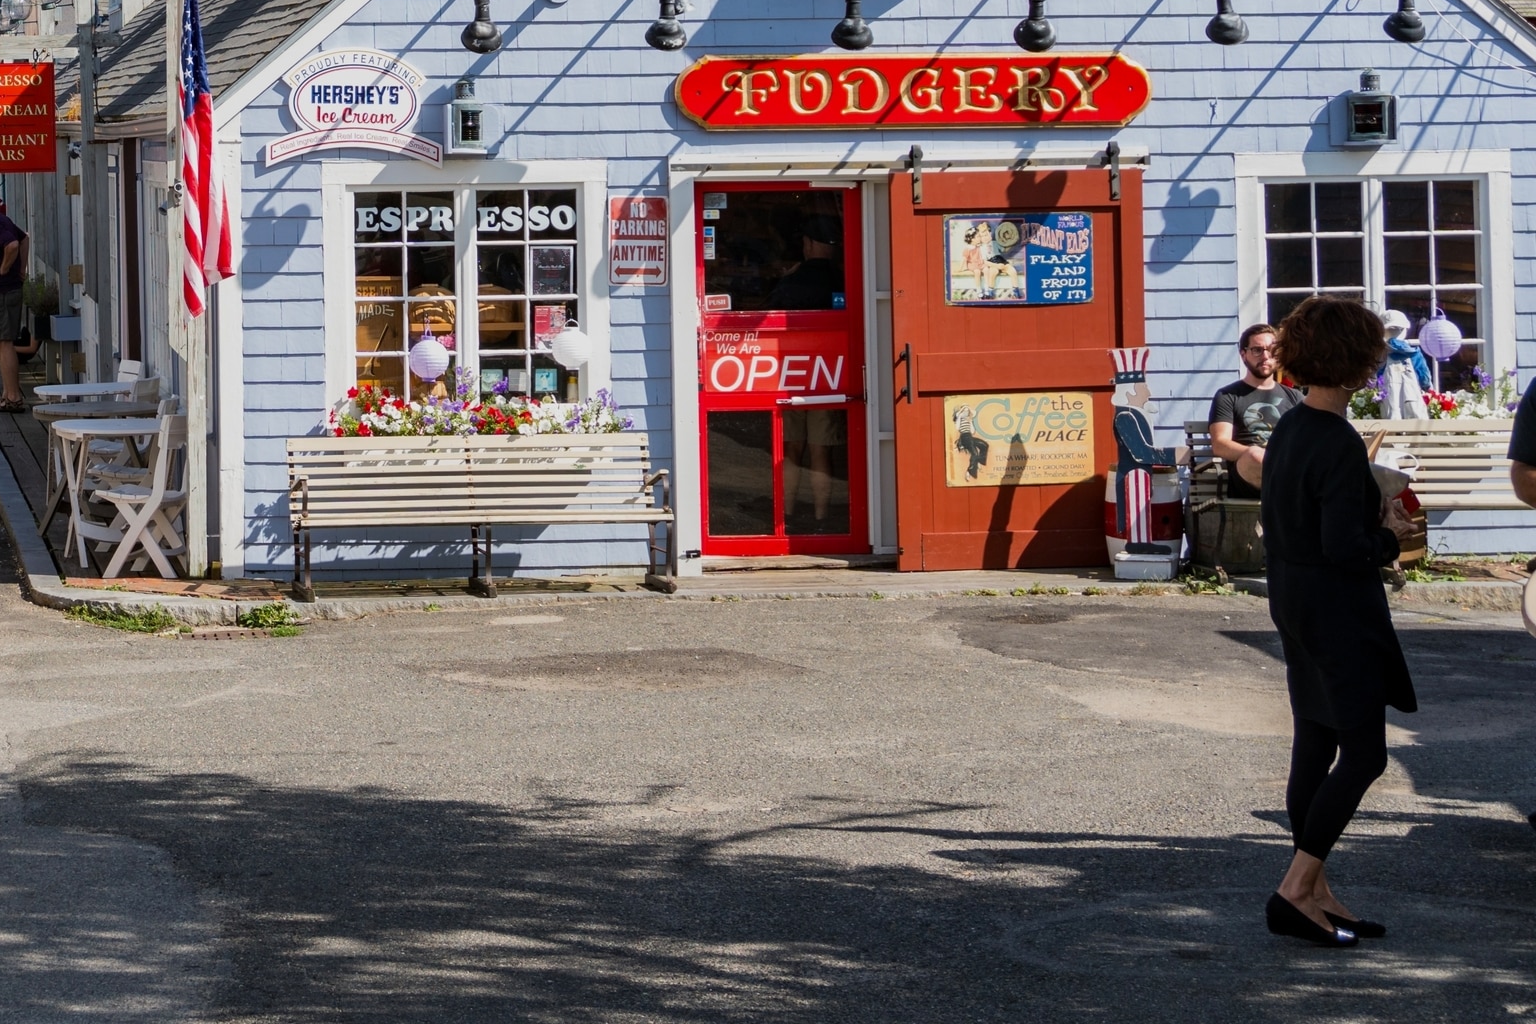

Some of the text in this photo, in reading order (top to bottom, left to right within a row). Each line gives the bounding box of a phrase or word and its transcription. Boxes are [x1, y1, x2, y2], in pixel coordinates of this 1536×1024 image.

[294, 53, 418, 85] PROUDLY FEATURING
[311, 85, 401, 105] HERSHEY'S
[722, 65, 1110, 115] FUDGERY
[316, 105, 396, 124] Ice Cream
[279, 141, 295, 152] Real
[336, 132, 352, 141] Real
[354, 132, 364, 141] Ice
[392, 136, 409, 146] Real
[630, 202, 647, 218] NO
[611, 219, 666, 237] PARKING
[1020, 222, 1090, 254] ELEPHANT EARS
[613, 244, 665, 262] ANYTIME
[1030, 254, 1086, 265] FLAKY
[1052, 266, 1086, 276] AND
[1041, 278, 1086, 289] PROUD
[708, 298, 726, 306] PUSH
[1043, 289, 1086, 300] OF IT!
[357, 304, 395, 325] MADE
[705, 330, 759, 342] Come in!
[716, 343, 761, 355] We Are
[710, 355, 844, 393] OPEN
[1051, 394, 1084, 411] the
[973, 396, 1088, 444] Coffee
[1034, 429, 1088, 443] PLACE
[995, 454, 1013, 462] TUNA
